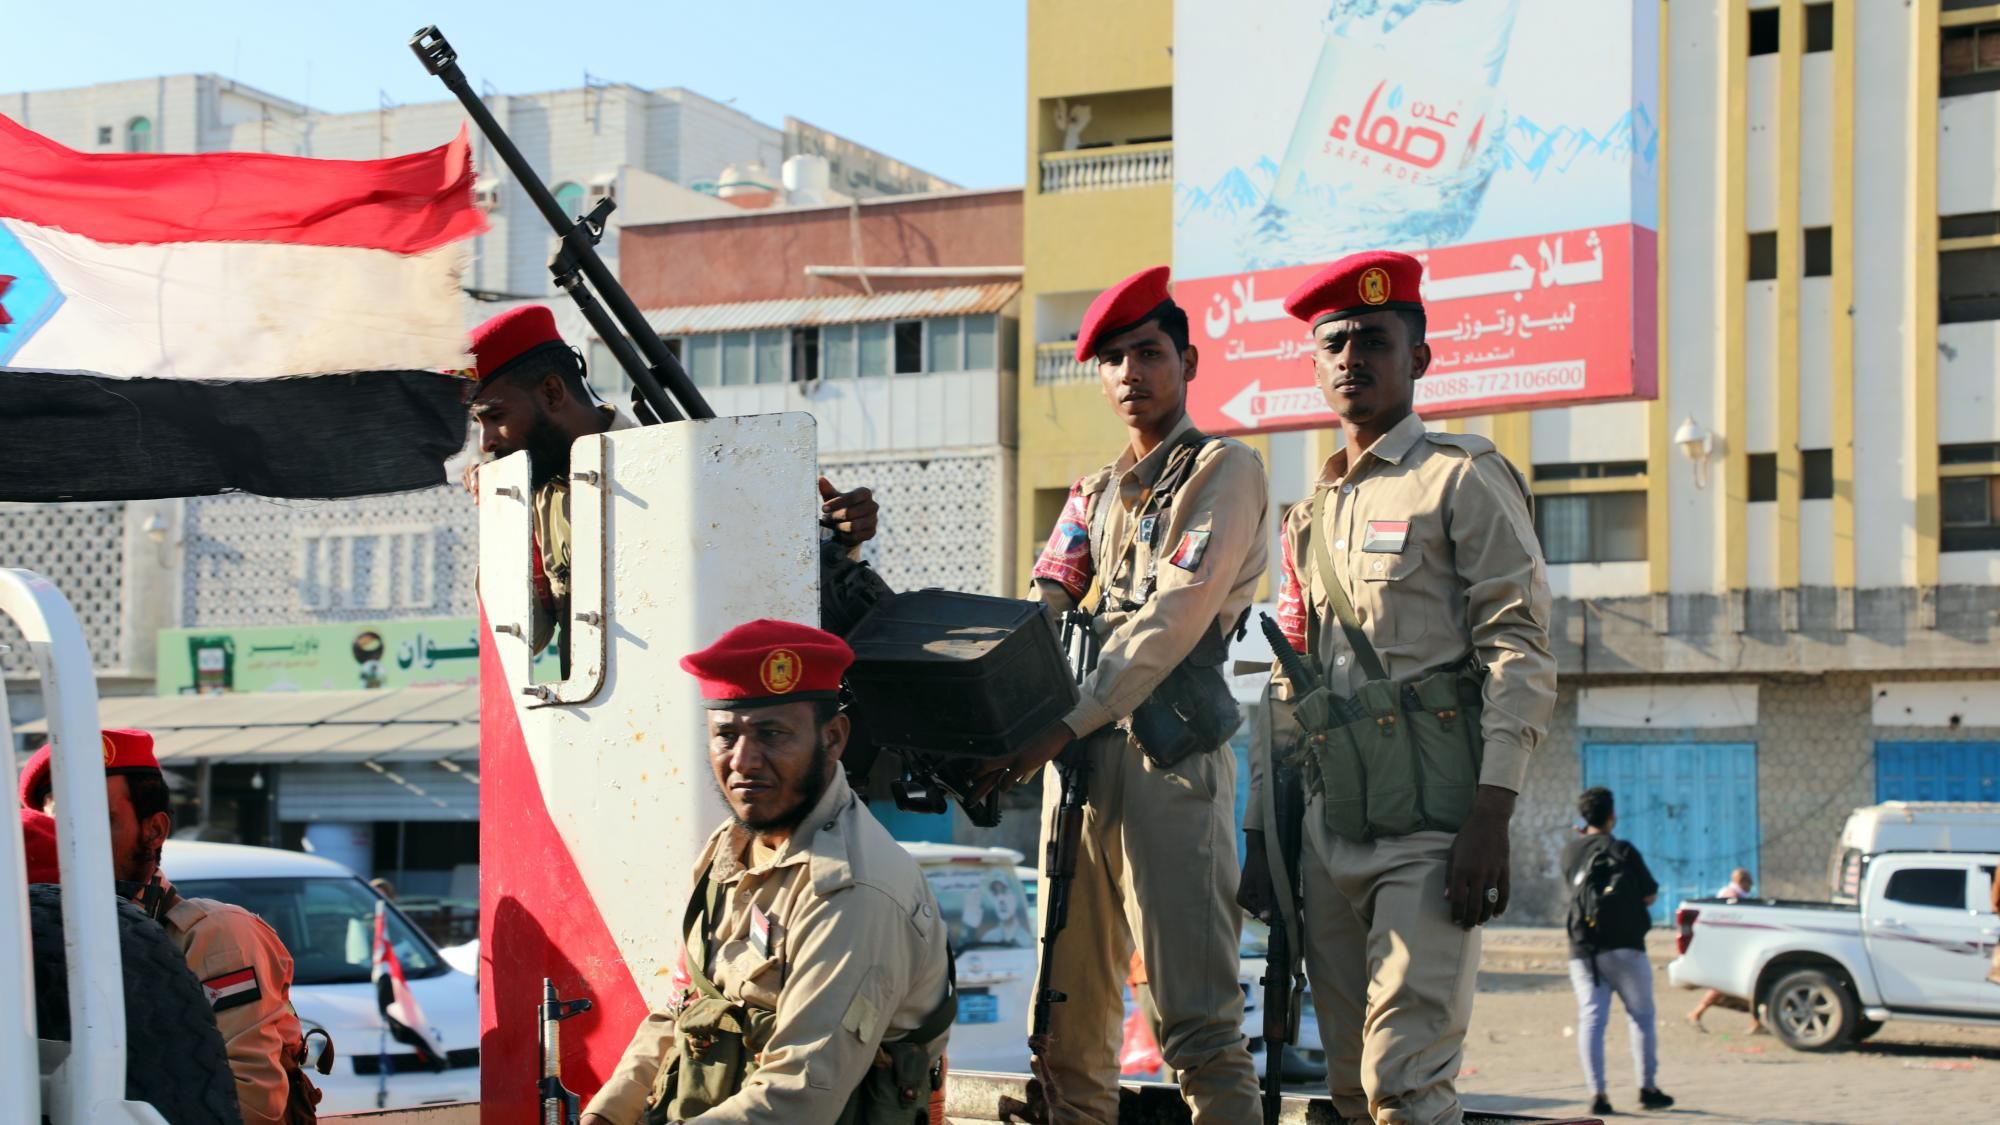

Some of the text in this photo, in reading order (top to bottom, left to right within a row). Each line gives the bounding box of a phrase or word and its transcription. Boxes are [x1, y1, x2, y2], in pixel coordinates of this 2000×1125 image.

[1328, 79, 1446, 169] صفاء
[1323, 141, 1370, 168] SAFA
[1425, 308, 1515, 342] وتوزي
[1518, 303, 1577, 339] لبيع
[1463, 346, 1515, 365] استعداد
